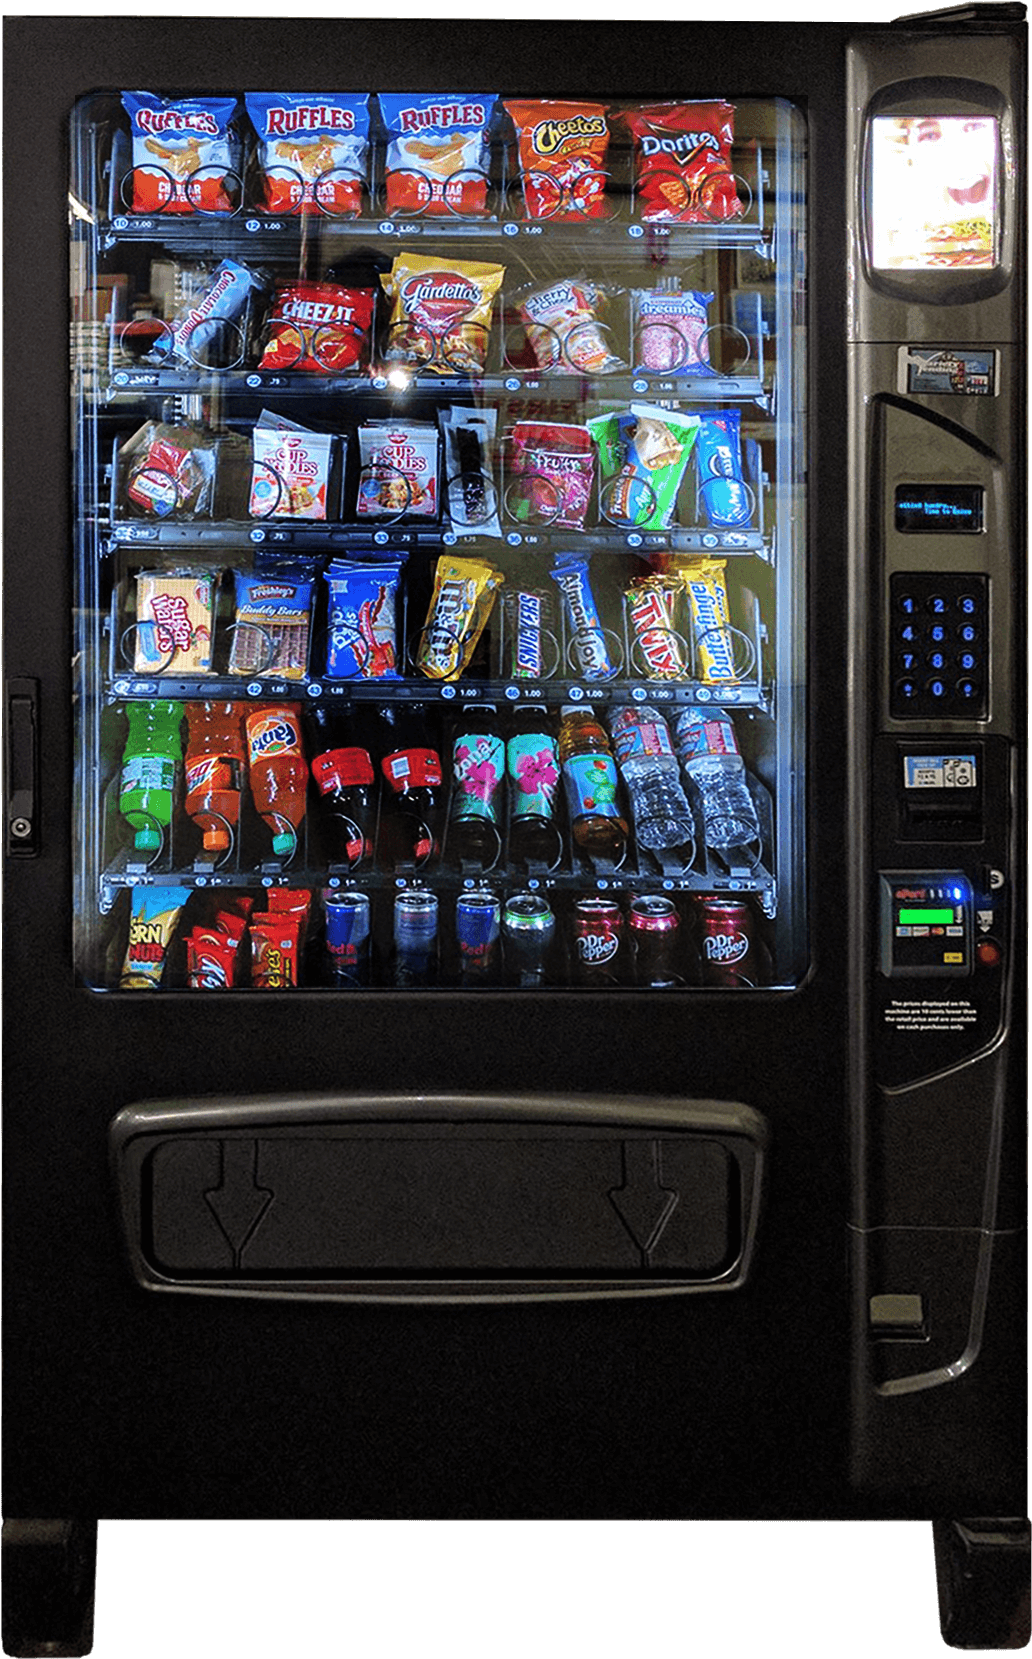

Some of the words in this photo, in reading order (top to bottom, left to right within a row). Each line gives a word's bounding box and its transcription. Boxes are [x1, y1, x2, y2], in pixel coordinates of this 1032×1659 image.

[136, 108, 219, 135] RUFFLES
[266, 105, 355, 135] RUFFLES
[401, 104, 484, 132] RUFFLES
[536, 115, 604, 153] Cheetos
[248, 222, 260, 231] 12
[400, 276, 482, 313] Gardetto's
[382, 446, 416, 461] CUP
[241, 603, 277, 619] Buddy
[278, 606, 302, 617] Bars
[902, 598, 914, 613] 1
[932, 598, 945, 613] 2
[962, 598, 975, 613] 3
[167, 597, 193, 653] Sugar
[519, 595, 540, 668] SNICKERS
[902, 626, 914, 641] 4
[932, 626, 945, 641] 5
[962, 626, 975, 641] 6
[902, 653, 914, 669] 7
[932, 653, 945, 669] 8
[962, 653, 975, 669] 9
[932, 681, 944, 696] 0
[251, 723, 295, 752] Fanta
[577, 937, 616, 961] Pepper
[588, 934, 605, 949] Dr
[704, 938, 746, 961] Pepper
[716, 934, 735, 948] Dr
